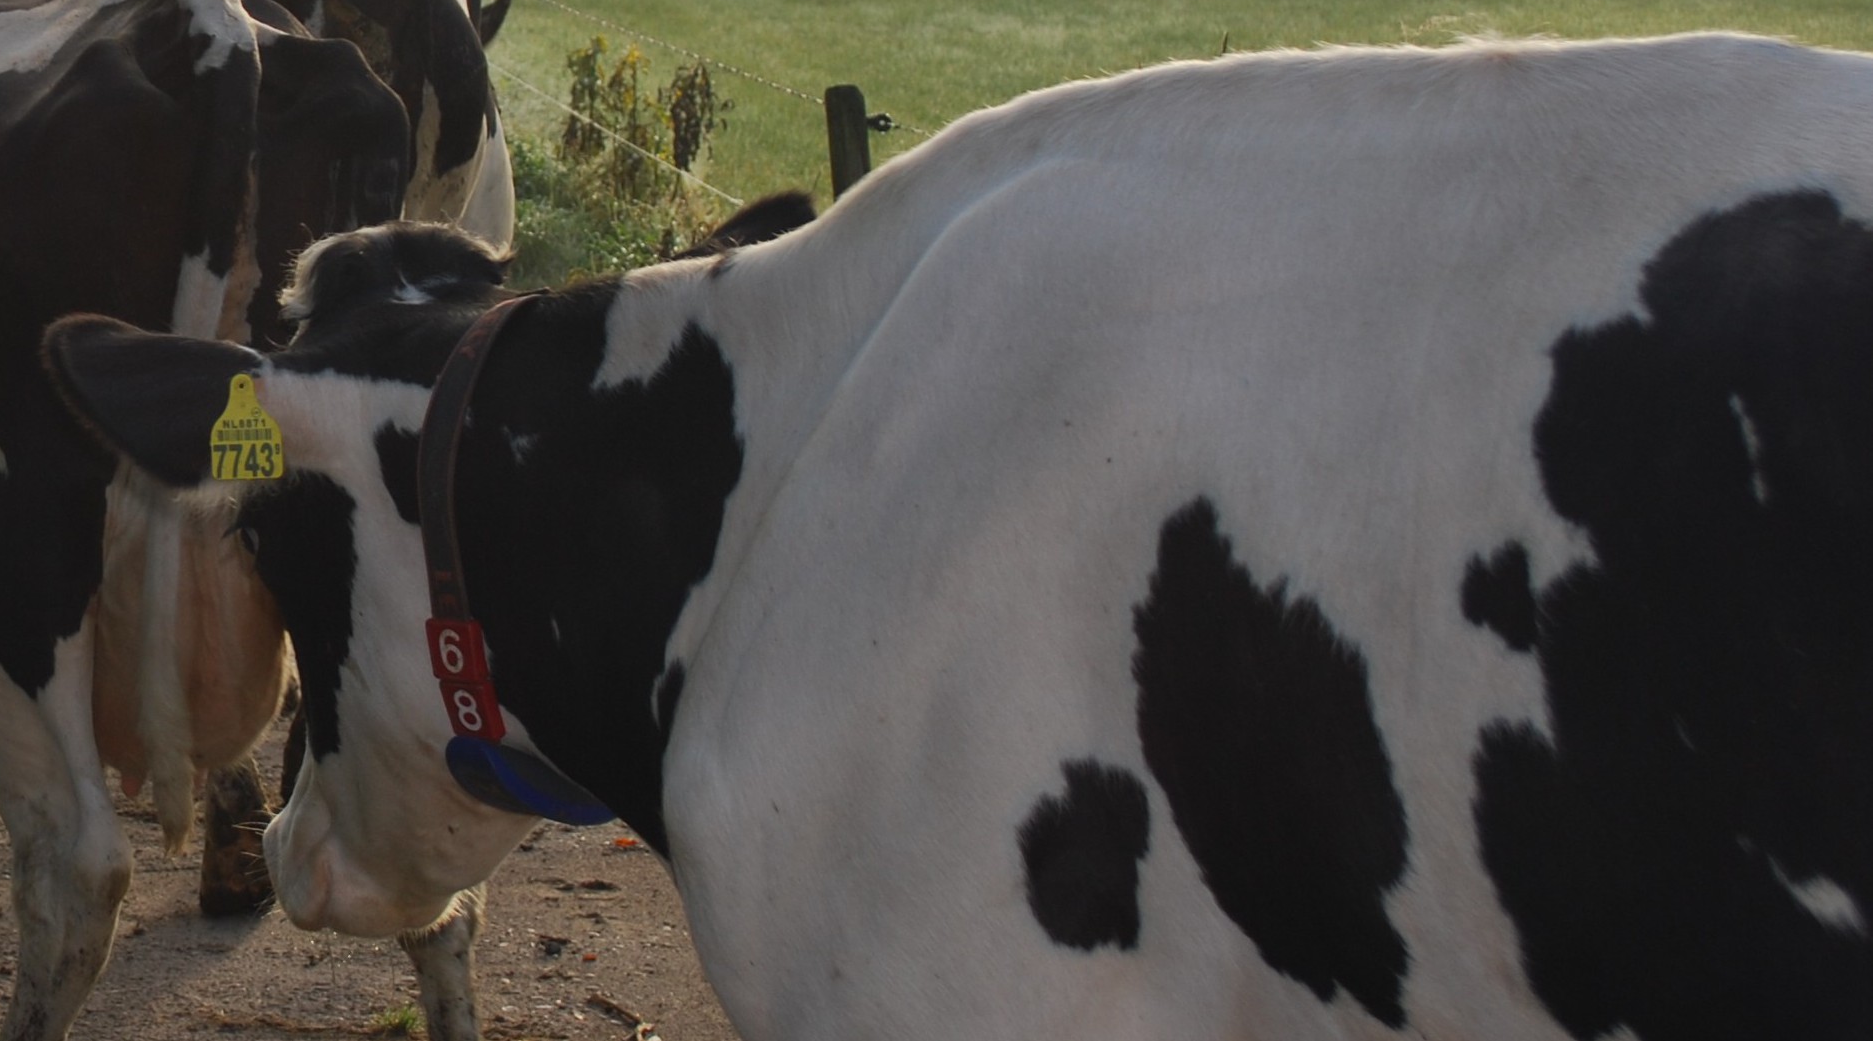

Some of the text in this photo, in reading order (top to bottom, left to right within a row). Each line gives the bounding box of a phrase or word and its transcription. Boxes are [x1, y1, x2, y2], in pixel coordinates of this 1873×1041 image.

[213, 442, 274, 479] 7743
[439, 629, 464, 673] 6
[453, 689, 482, 731] 8
